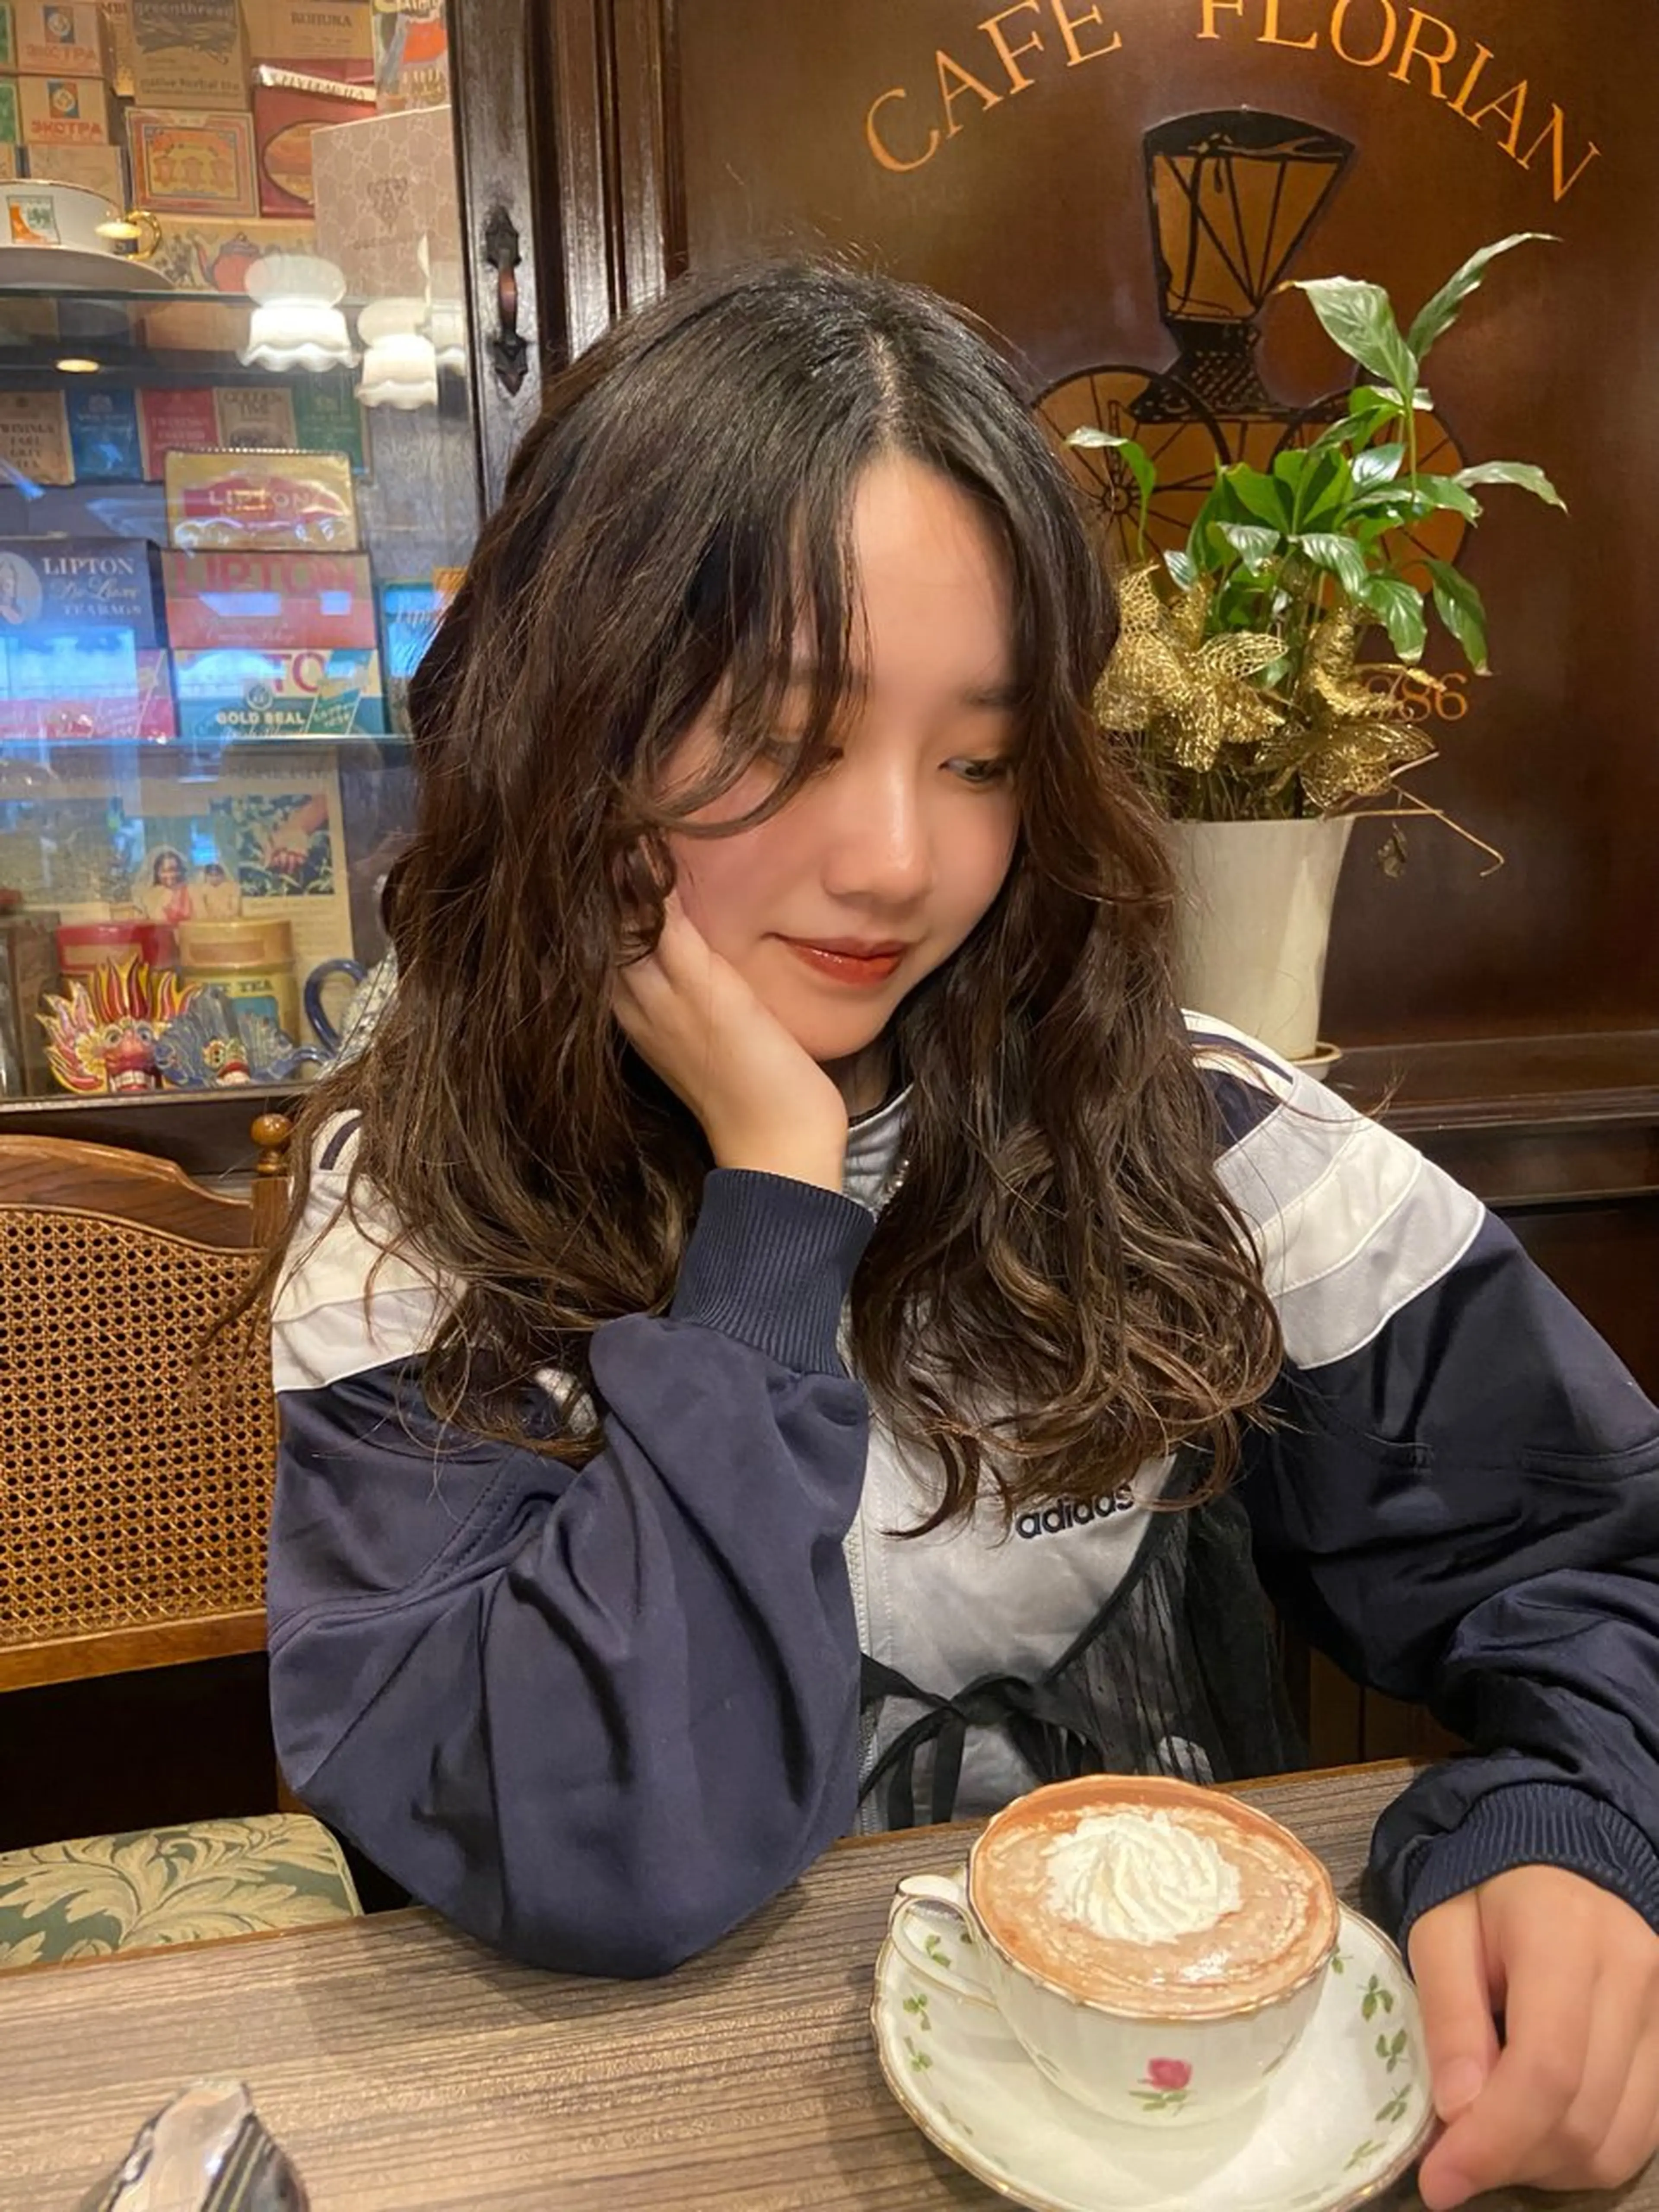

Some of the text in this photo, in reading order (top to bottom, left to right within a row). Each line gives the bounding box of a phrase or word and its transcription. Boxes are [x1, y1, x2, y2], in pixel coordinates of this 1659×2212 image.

[1196, 0, 1602, 202] FLORIAN
[42, 556, 135, 575] LIPTON
[217, 711, 259, 725] GOLD
[1016, 1483, 1135, 1539] adidas
